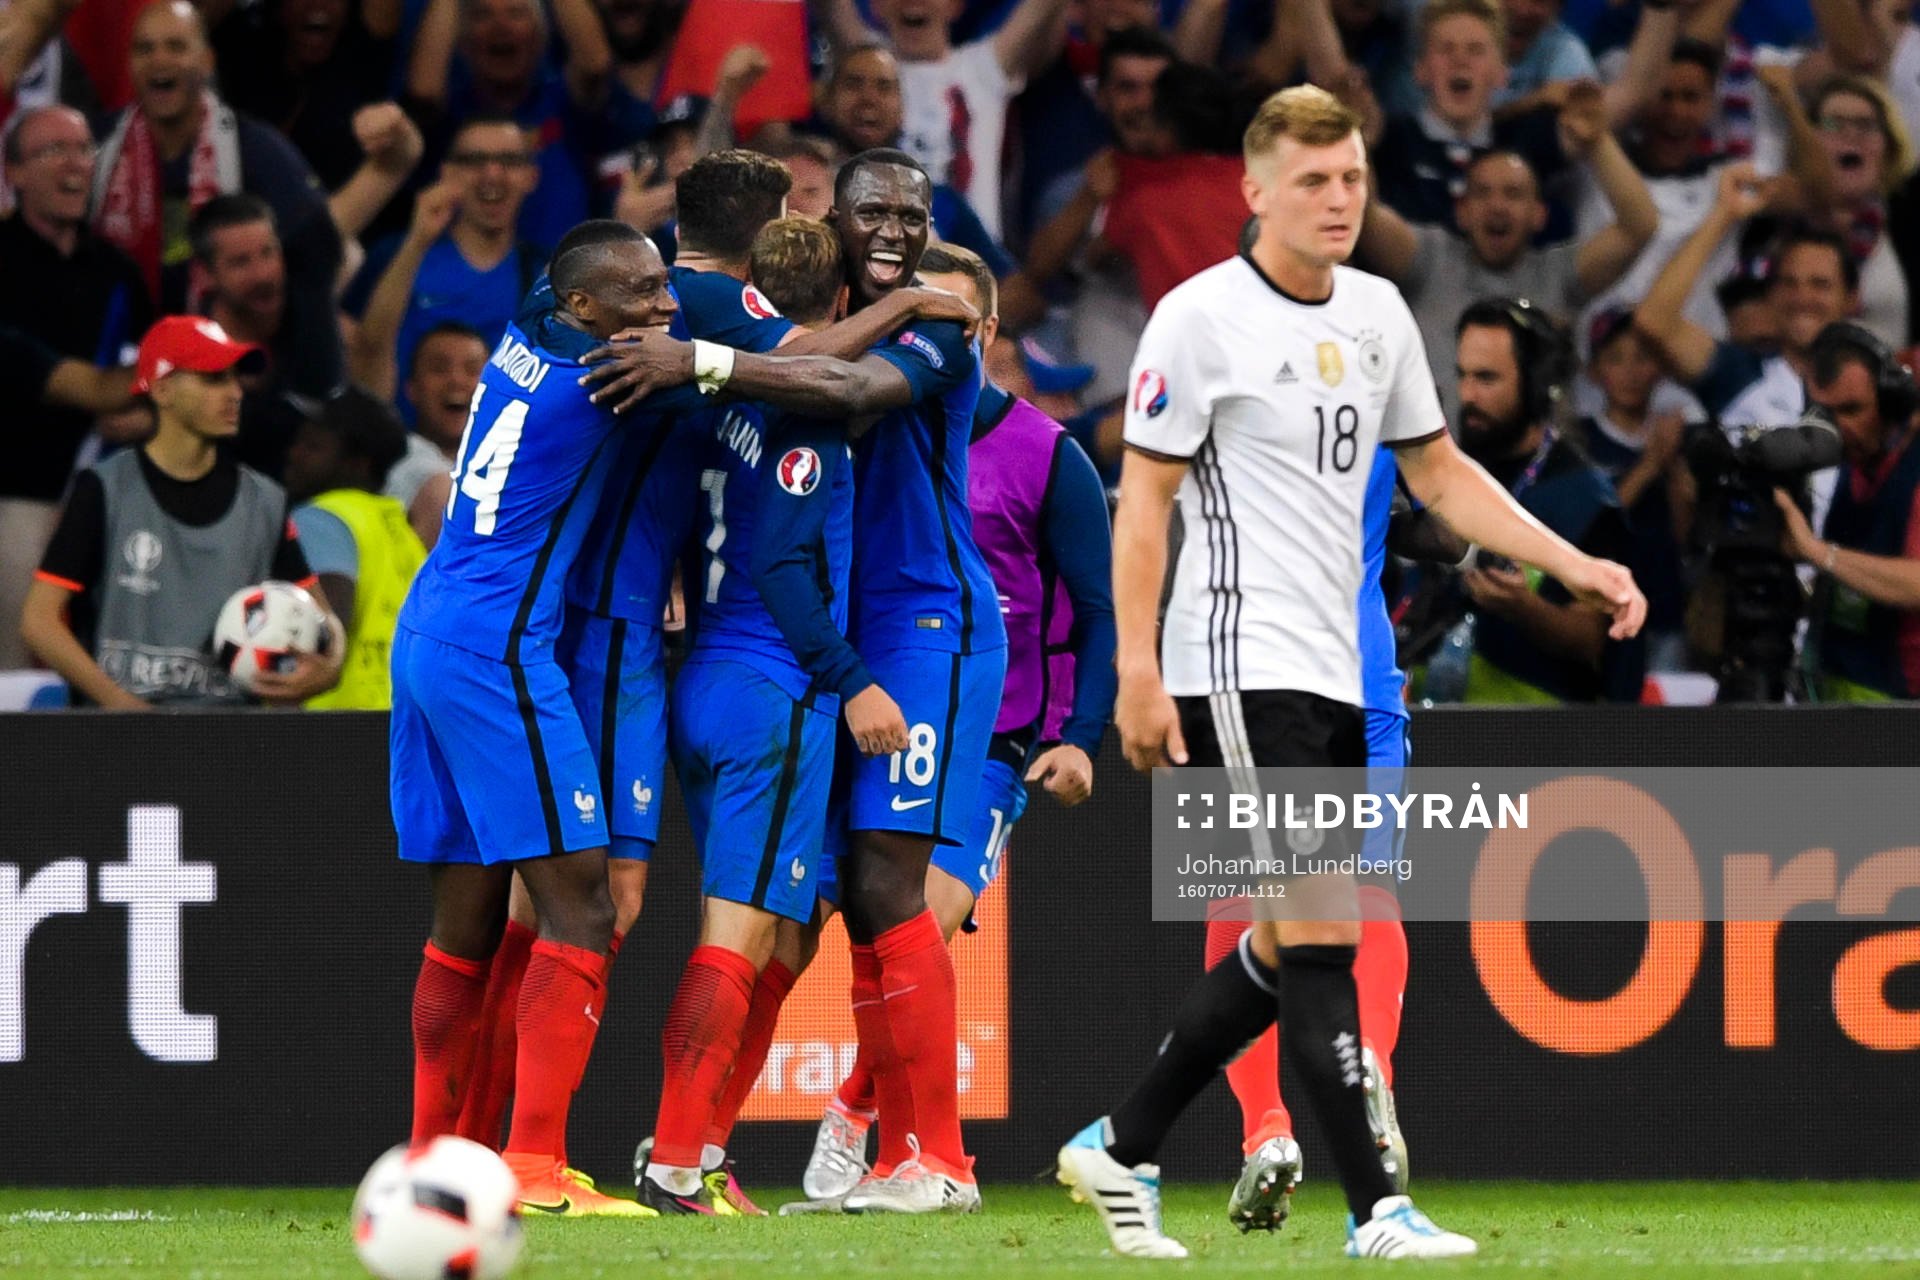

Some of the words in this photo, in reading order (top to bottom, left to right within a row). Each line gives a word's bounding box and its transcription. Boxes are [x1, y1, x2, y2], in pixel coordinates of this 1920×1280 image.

[447, 382, 530, 536] 14
[1314, 404, 1359, 474] 18
[889, 722, 937, 787] 18
